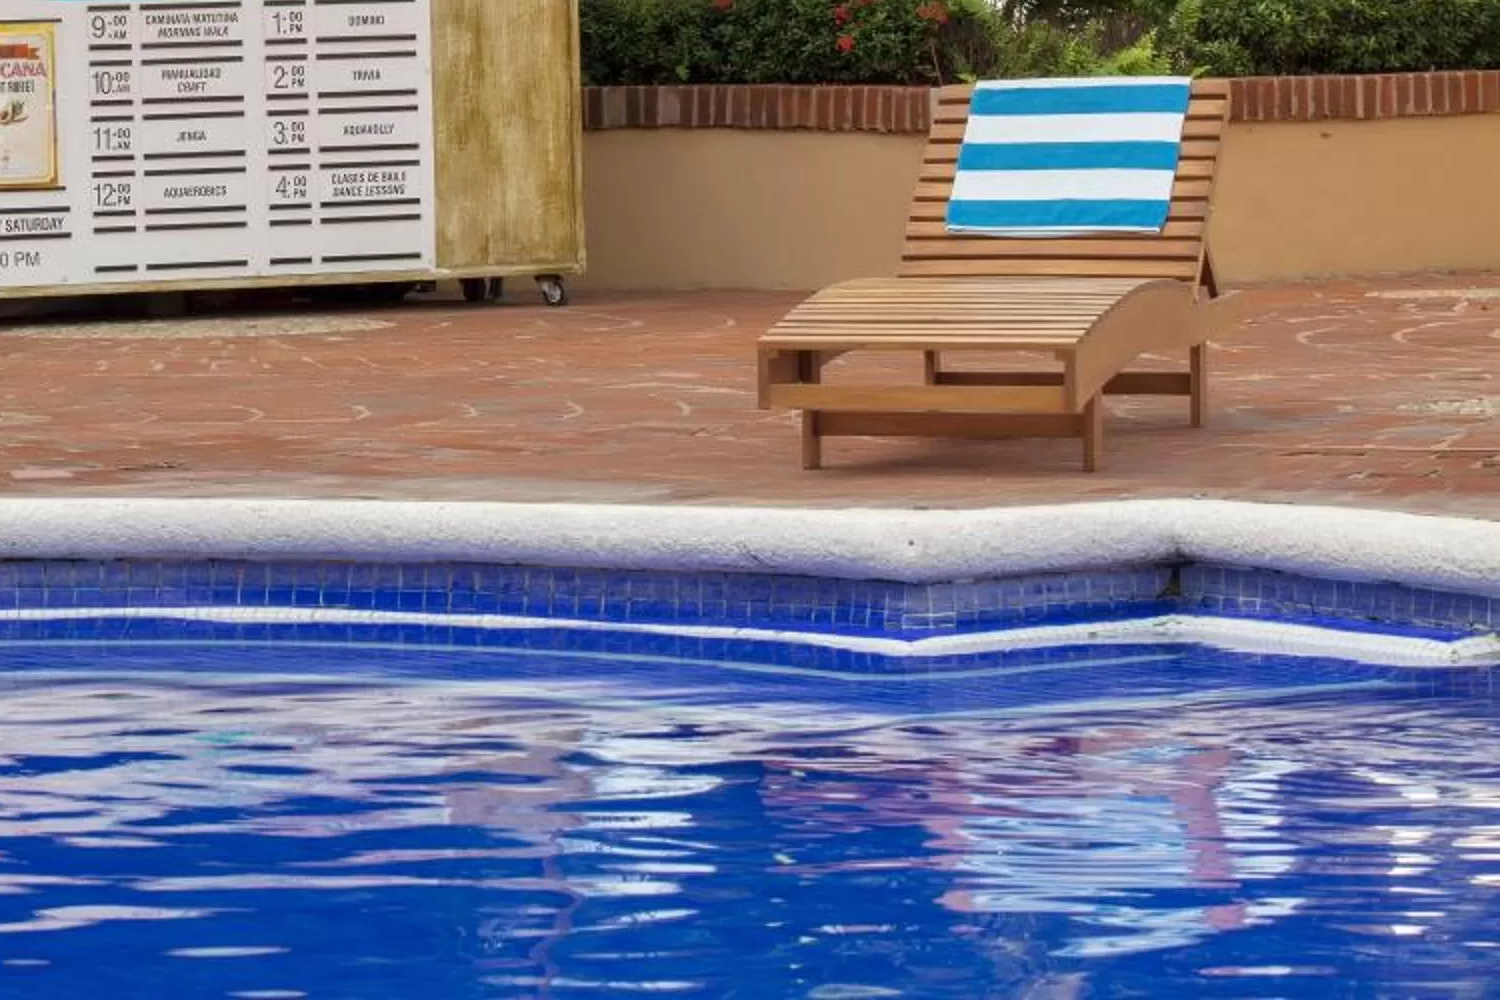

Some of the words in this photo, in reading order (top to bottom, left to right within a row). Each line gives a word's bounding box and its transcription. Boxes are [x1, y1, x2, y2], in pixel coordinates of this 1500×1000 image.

[177, 81, 206, 93] CRAFT
[331, 173, 365, 185] CLASES
[367, 172, 381, 183] DE
[332, 186, 362, 197] DANCE
[365, 184, 406, 196] LESSONS
[5, 217, 64, 233] SATURDAY
[13, 251, 41, 267] PM
